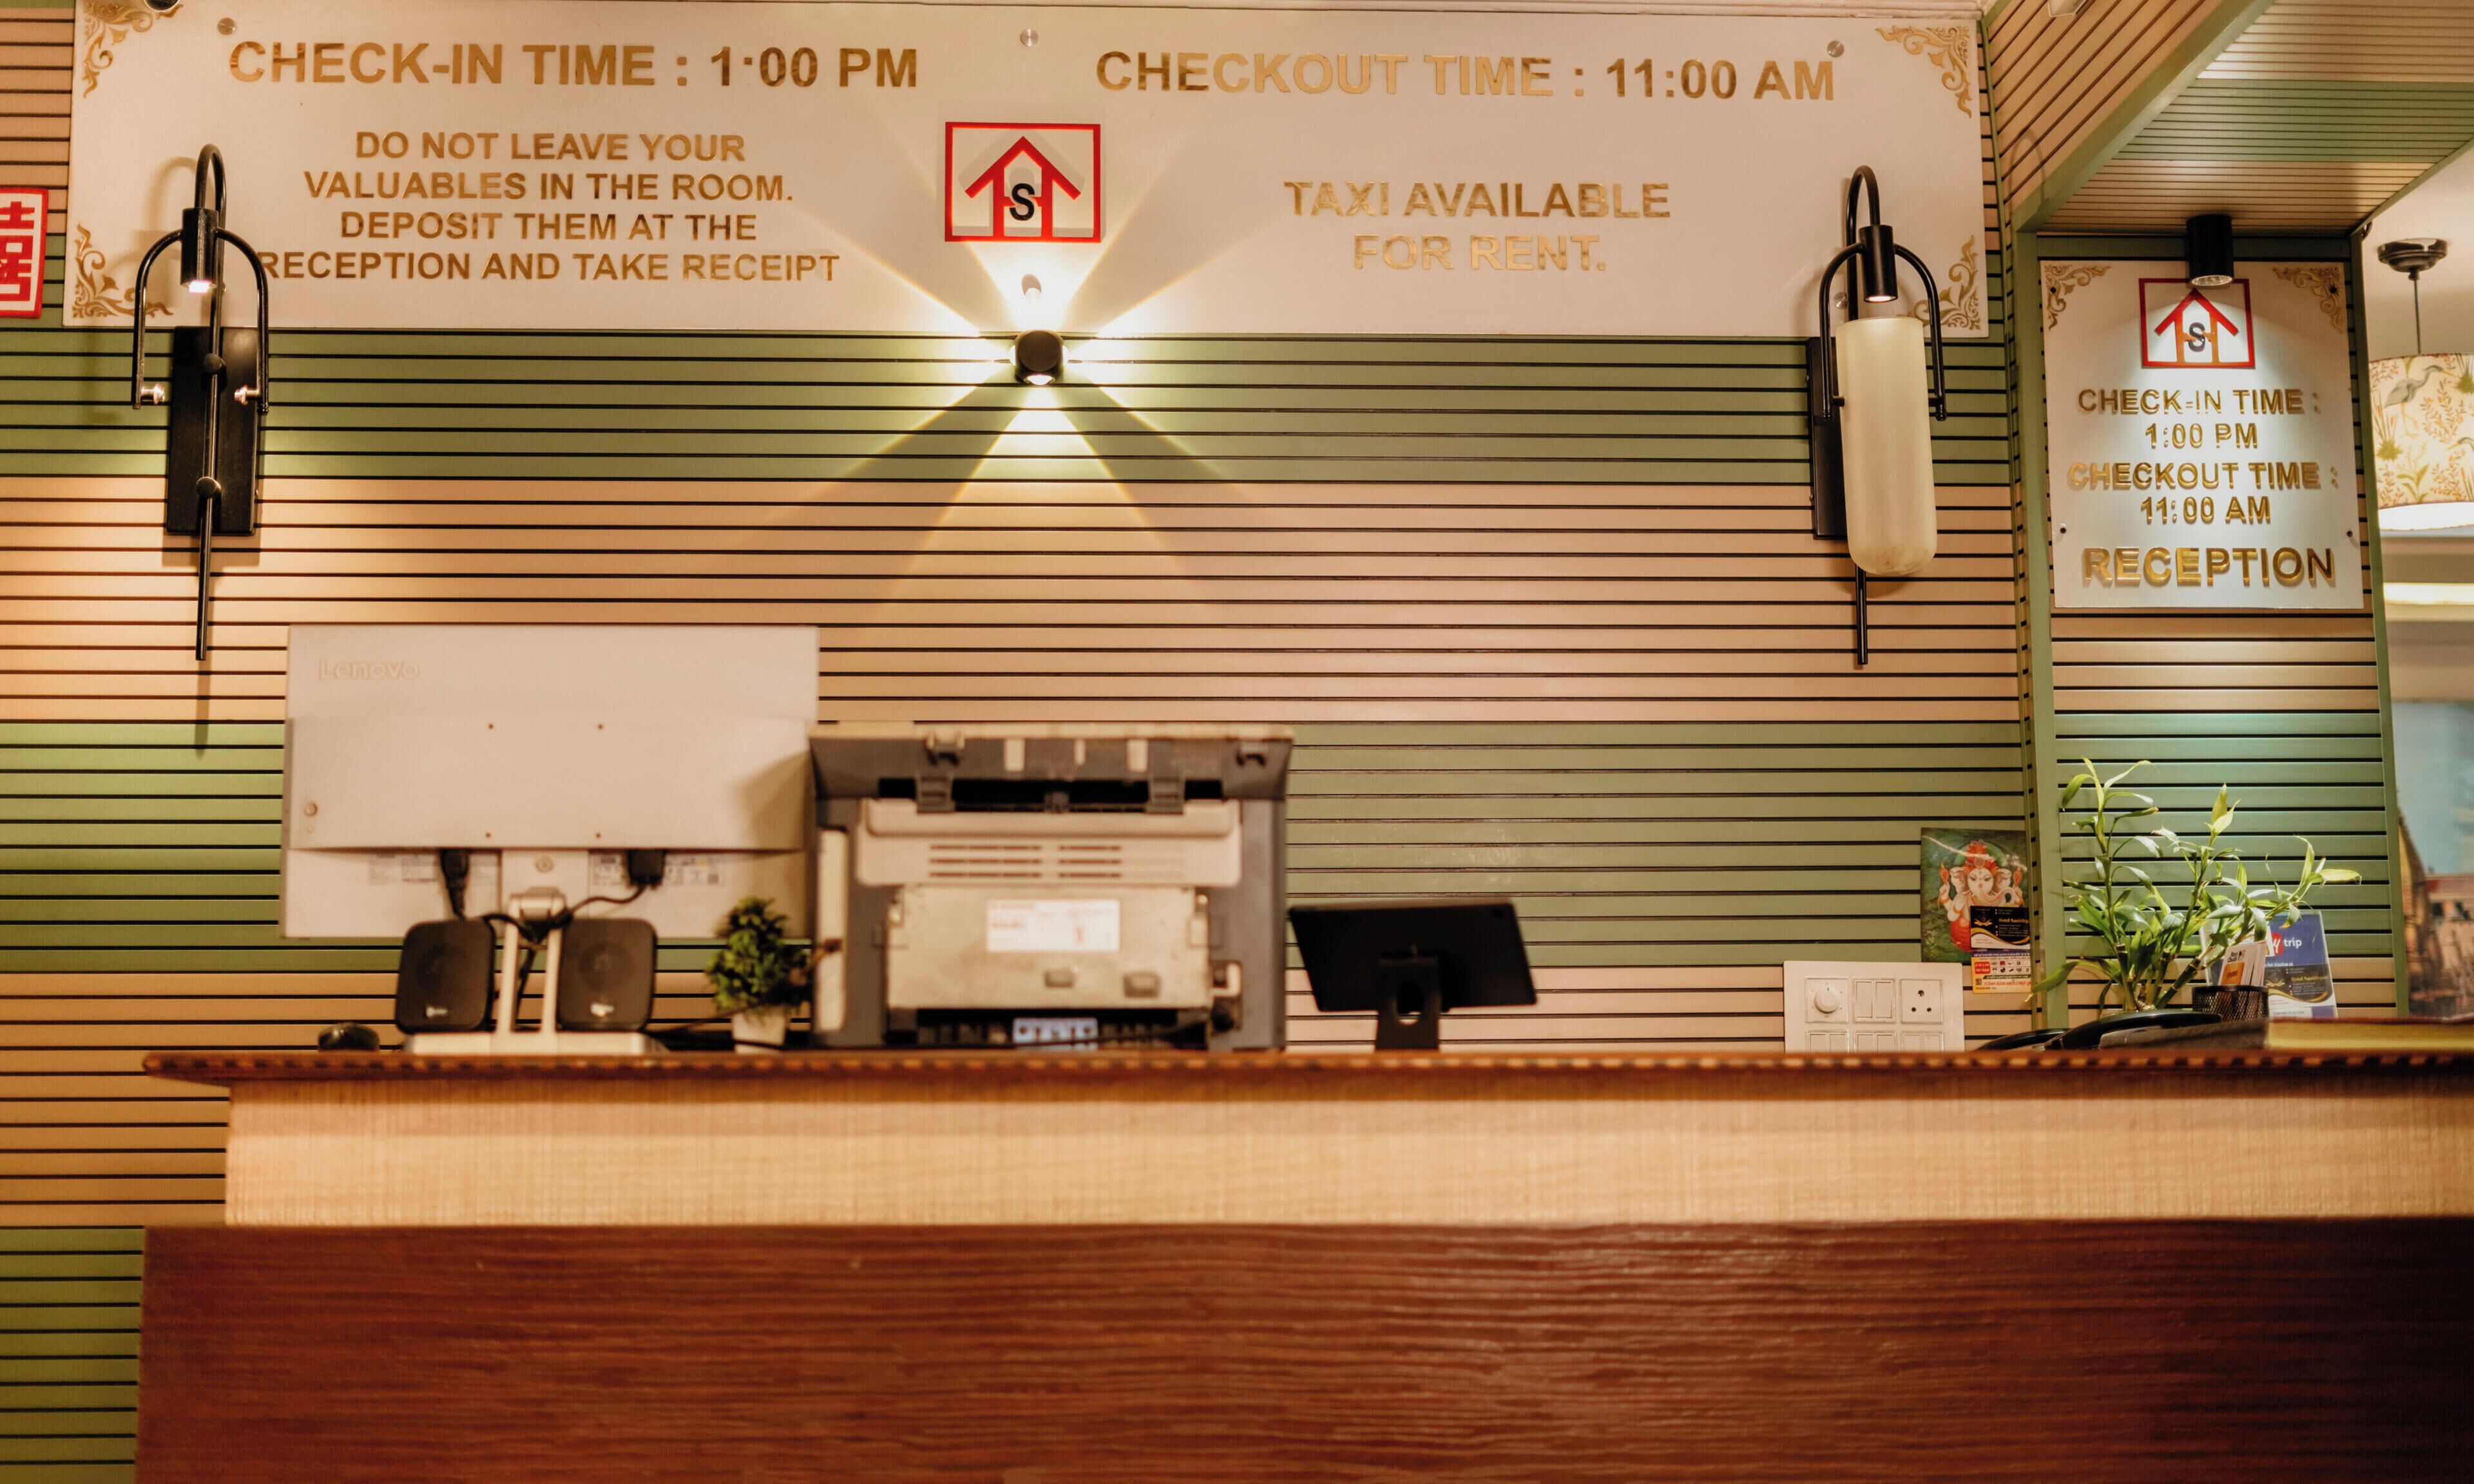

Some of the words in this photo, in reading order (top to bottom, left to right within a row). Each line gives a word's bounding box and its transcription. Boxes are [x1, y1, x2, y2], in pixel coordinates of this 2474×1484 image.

[229, 41, 503, 84] CHECK-IN
[523, 44, 655, 86] TIME
[677, 57, 687, 86] :
[839, 48, 917, 88] PM
[1097, 50, 1407, 94] CHECKOUT
[1424, 55, 1553, 96] TIME
[1574, 68, 1584, 97] :
[1607, 58, 1737, 99] 11:00
[1753, 60, 1834, 100] AM
[356, 131, 409, 159] DO
[423, 132, 499, 160] NOT
[511, 133, 628, 160] LEAVE
[639, 134, 745, 162] YOUR
[304, 171, 526, 200] VALUABLES
[541, 173, 573, 200] IN
[586, 173, 658, 200] THE
[672, 173, 793, 202] ROOM.
[1284, 181, 1389, 217] TAXI
[1405, 182, 1670, 219] AVAILABLE
[1010, 183, 1035, 221] S
[340, 211, 503, 240] DEPOSIT
[513, 213, 617, 240] THEM
[628, 214, 673, 240] AT
[685, 214, 756, 241] THE
[258, 252, 470, 280] RECEPTION
[481, 252, 560, 280] AND
[573, 253, 668, 281] TAKE
[683, 254, 839, 282] RECEIPT
[1354, 234, 1453, 271] FOR
[1471, 235, 1606, 271] RENT.
[2189, 322, 2207, 352] S
[2078, 389, 2221, 414] CHECK-IN
[2232, 389, 2305, 414] TIME
[2145, 423, 2203, 449] 1:00
[2215, 423, 2258, 449] PM
[2068, 462, 2239, 490] CHECKOUT
[2248, 462, 2321, 490] TIME
[2140, 496, 2214, 524] 11:00
[2225, 496, 2271, 524] AM
[2083, 547, 2336, 587] RECEPTION
[318, 658, 421, 681] Lenovo
[2283, 938, 2303, 949] trip
